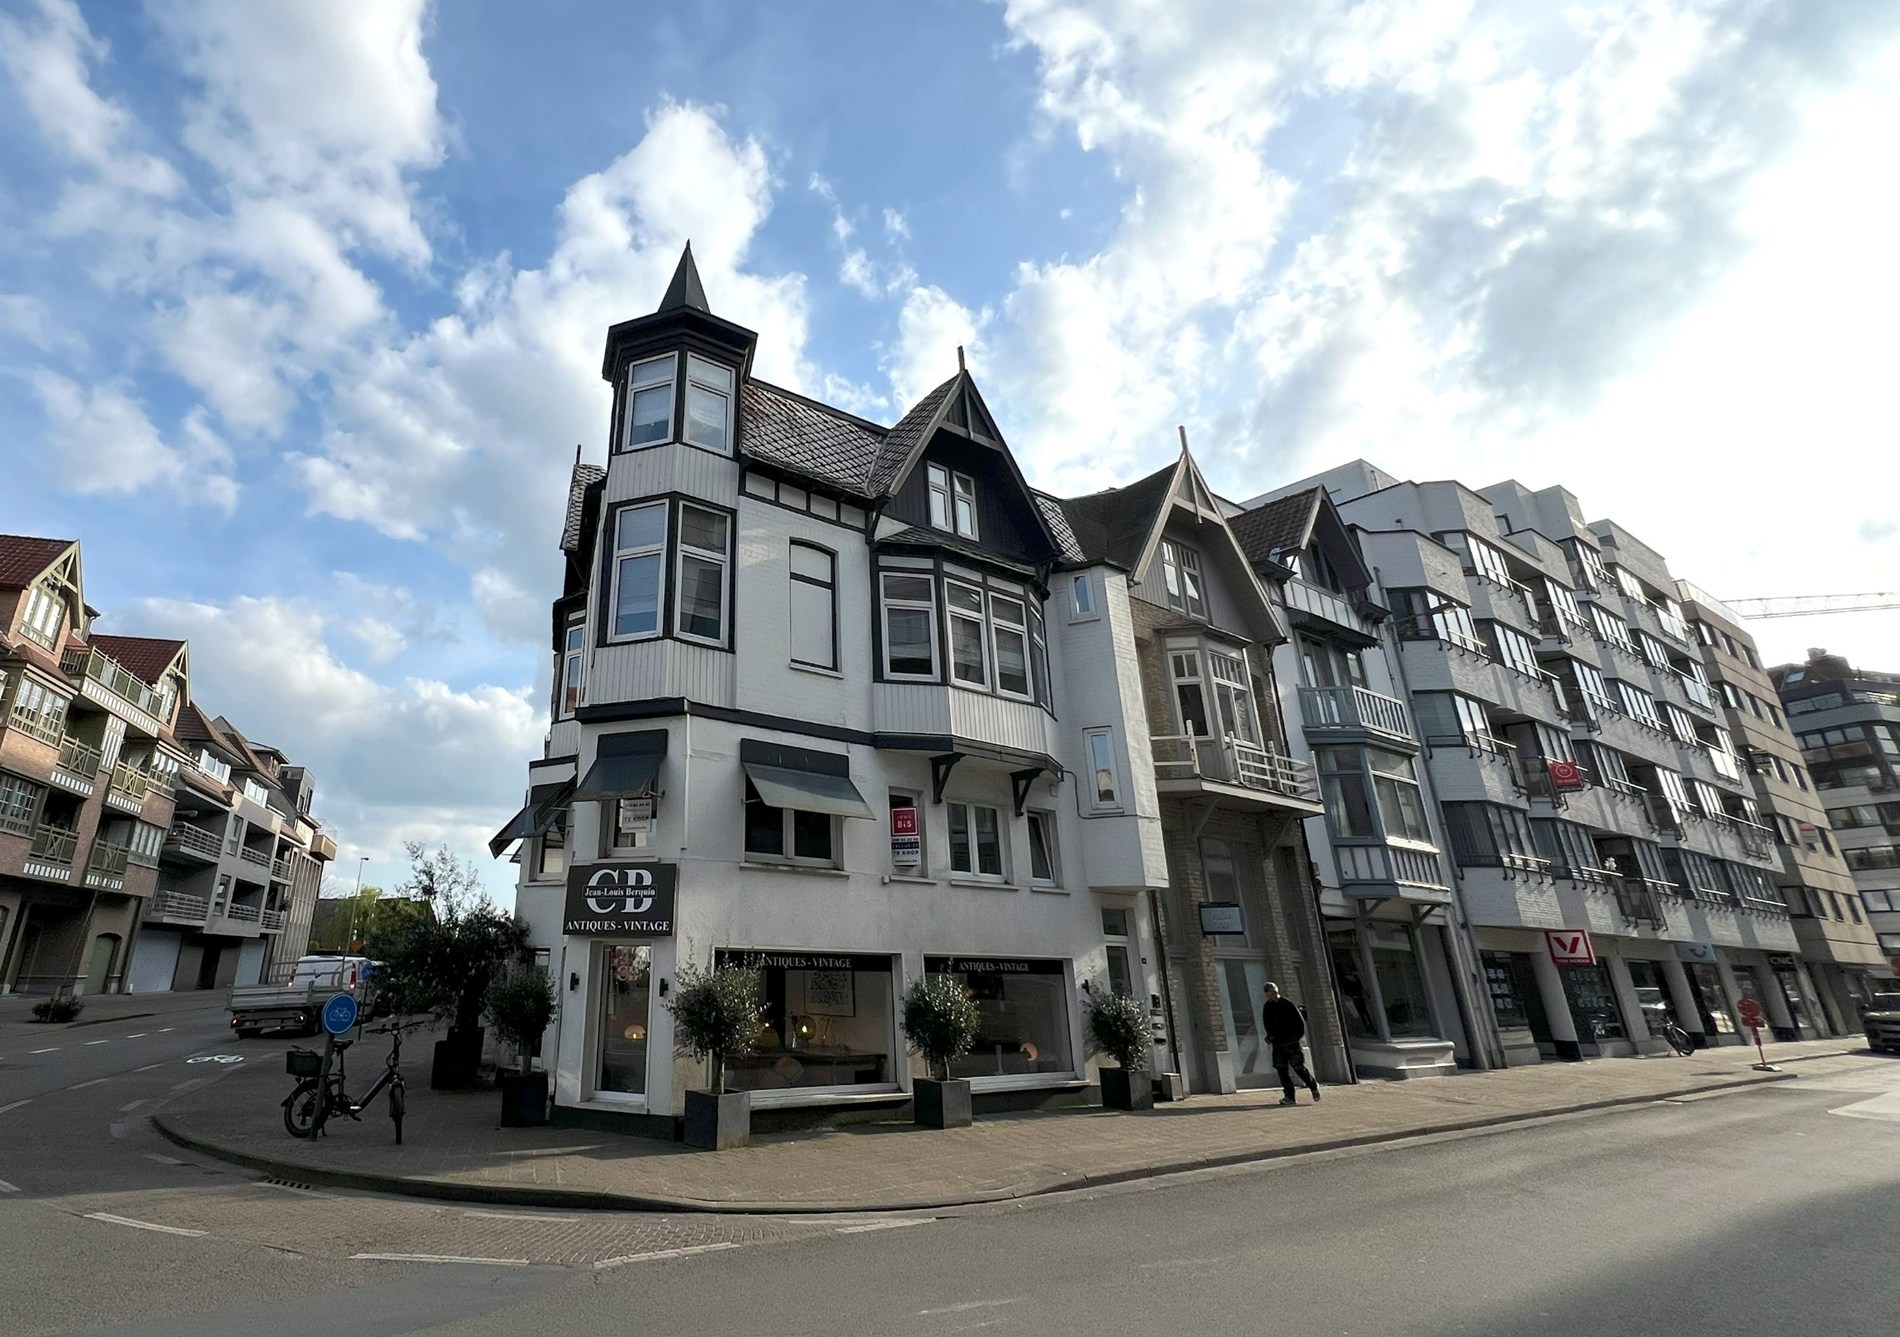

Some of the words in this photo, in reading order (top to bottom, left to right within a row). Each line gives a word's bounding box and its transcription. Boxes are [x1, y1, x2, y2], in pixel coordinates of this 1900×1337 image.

[584, 887, 624, 896] Jean-Louis
[625, 887, 656, 898] Berquin
[565, 920, 616, 933] ANTIQUES
[623, 920, 670, 932] VINTAGE
[812, 957, 852, 968] VINTAGE
[959, 961, 995, 972] ANTIQUES
[999, 962, 1030, 971] VINTAGE
